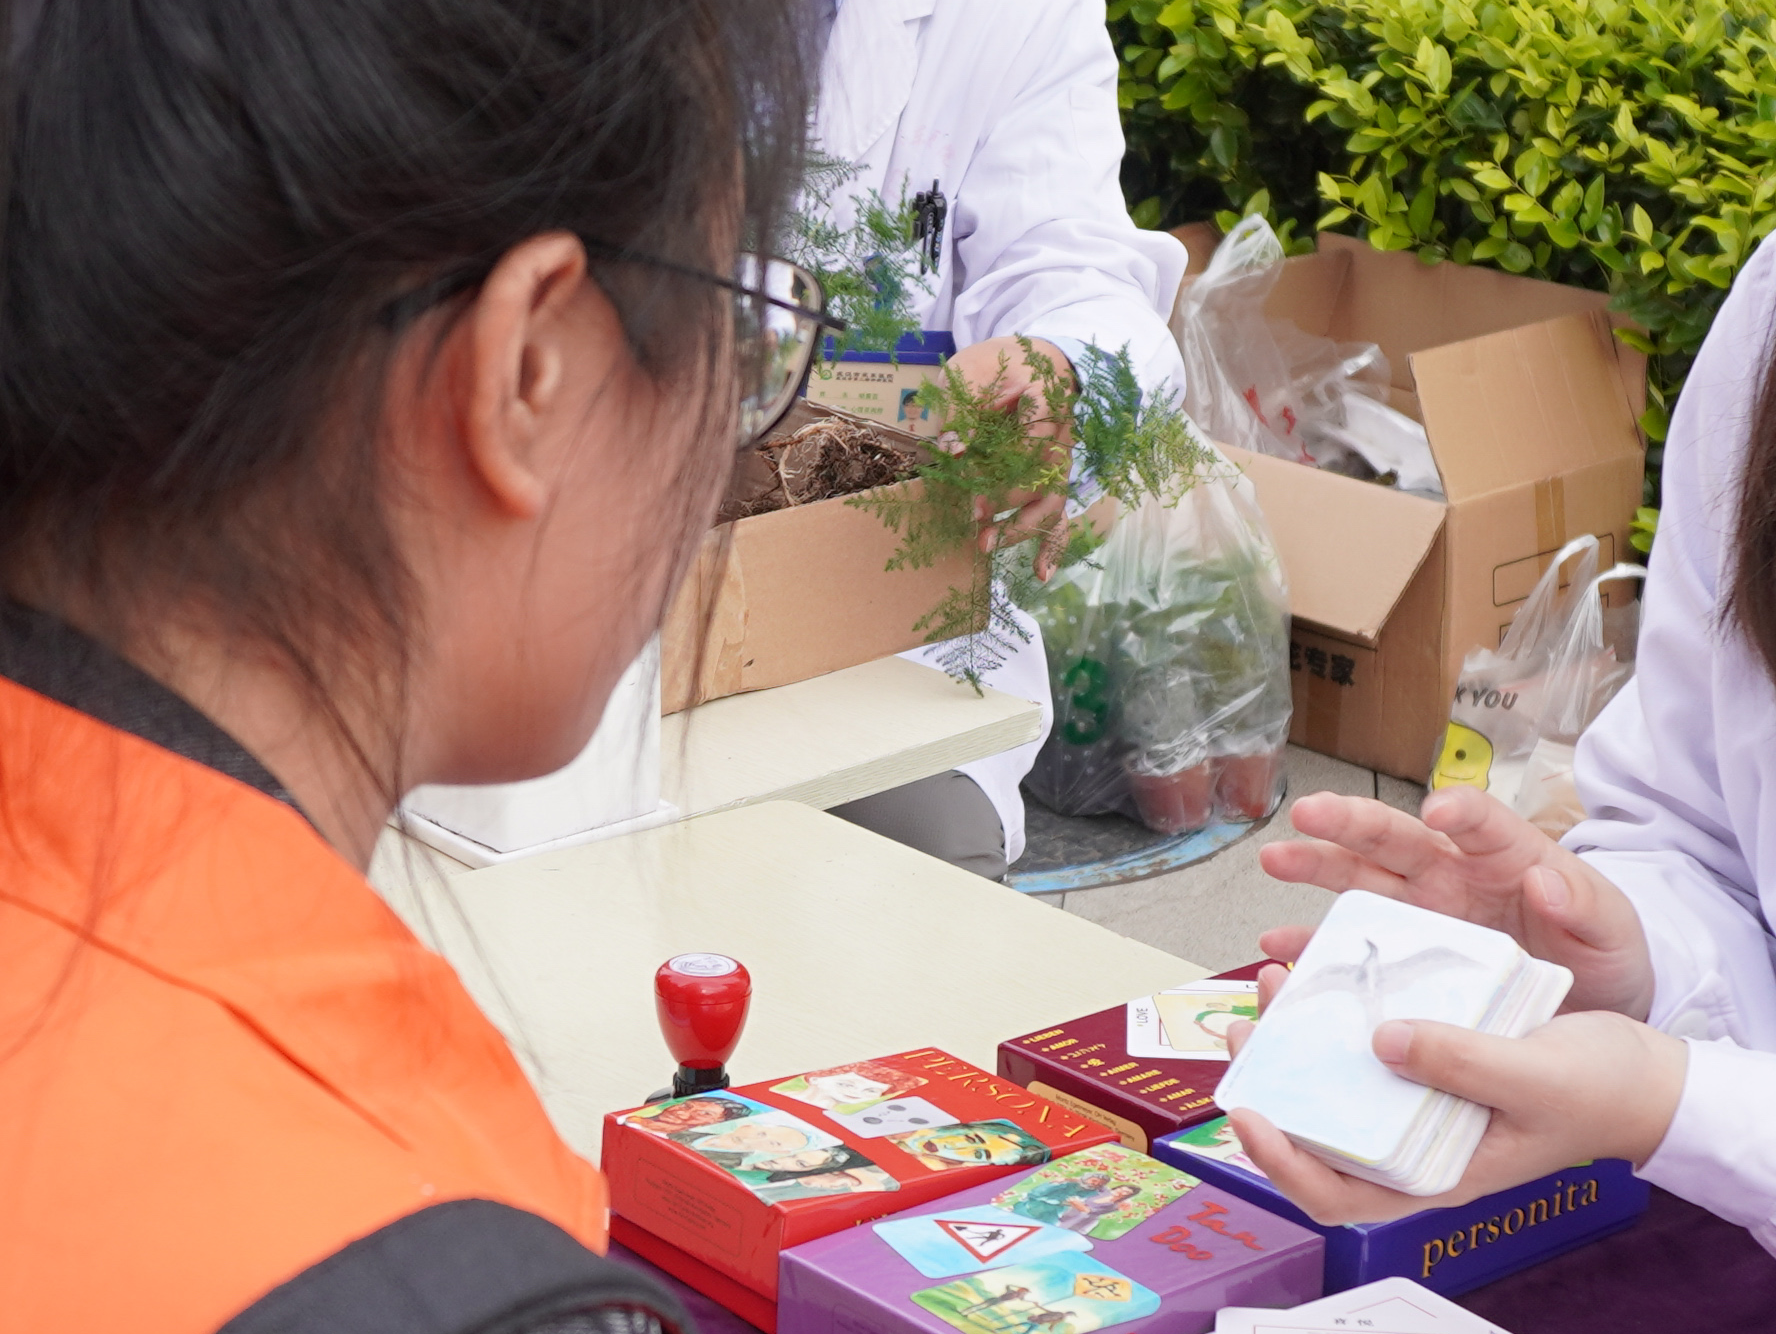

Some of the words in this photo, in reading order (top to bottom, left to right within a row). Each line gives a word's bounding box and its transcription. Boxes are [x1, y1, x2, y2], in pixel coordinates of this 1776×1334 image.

[1472, 688, 1520, 712] YOU
[1149, 1224, 1216, 1265] Doo
[1186, 1199, 1267, 1253] Tan
[1421, 1178, 1600, 1279] personita
